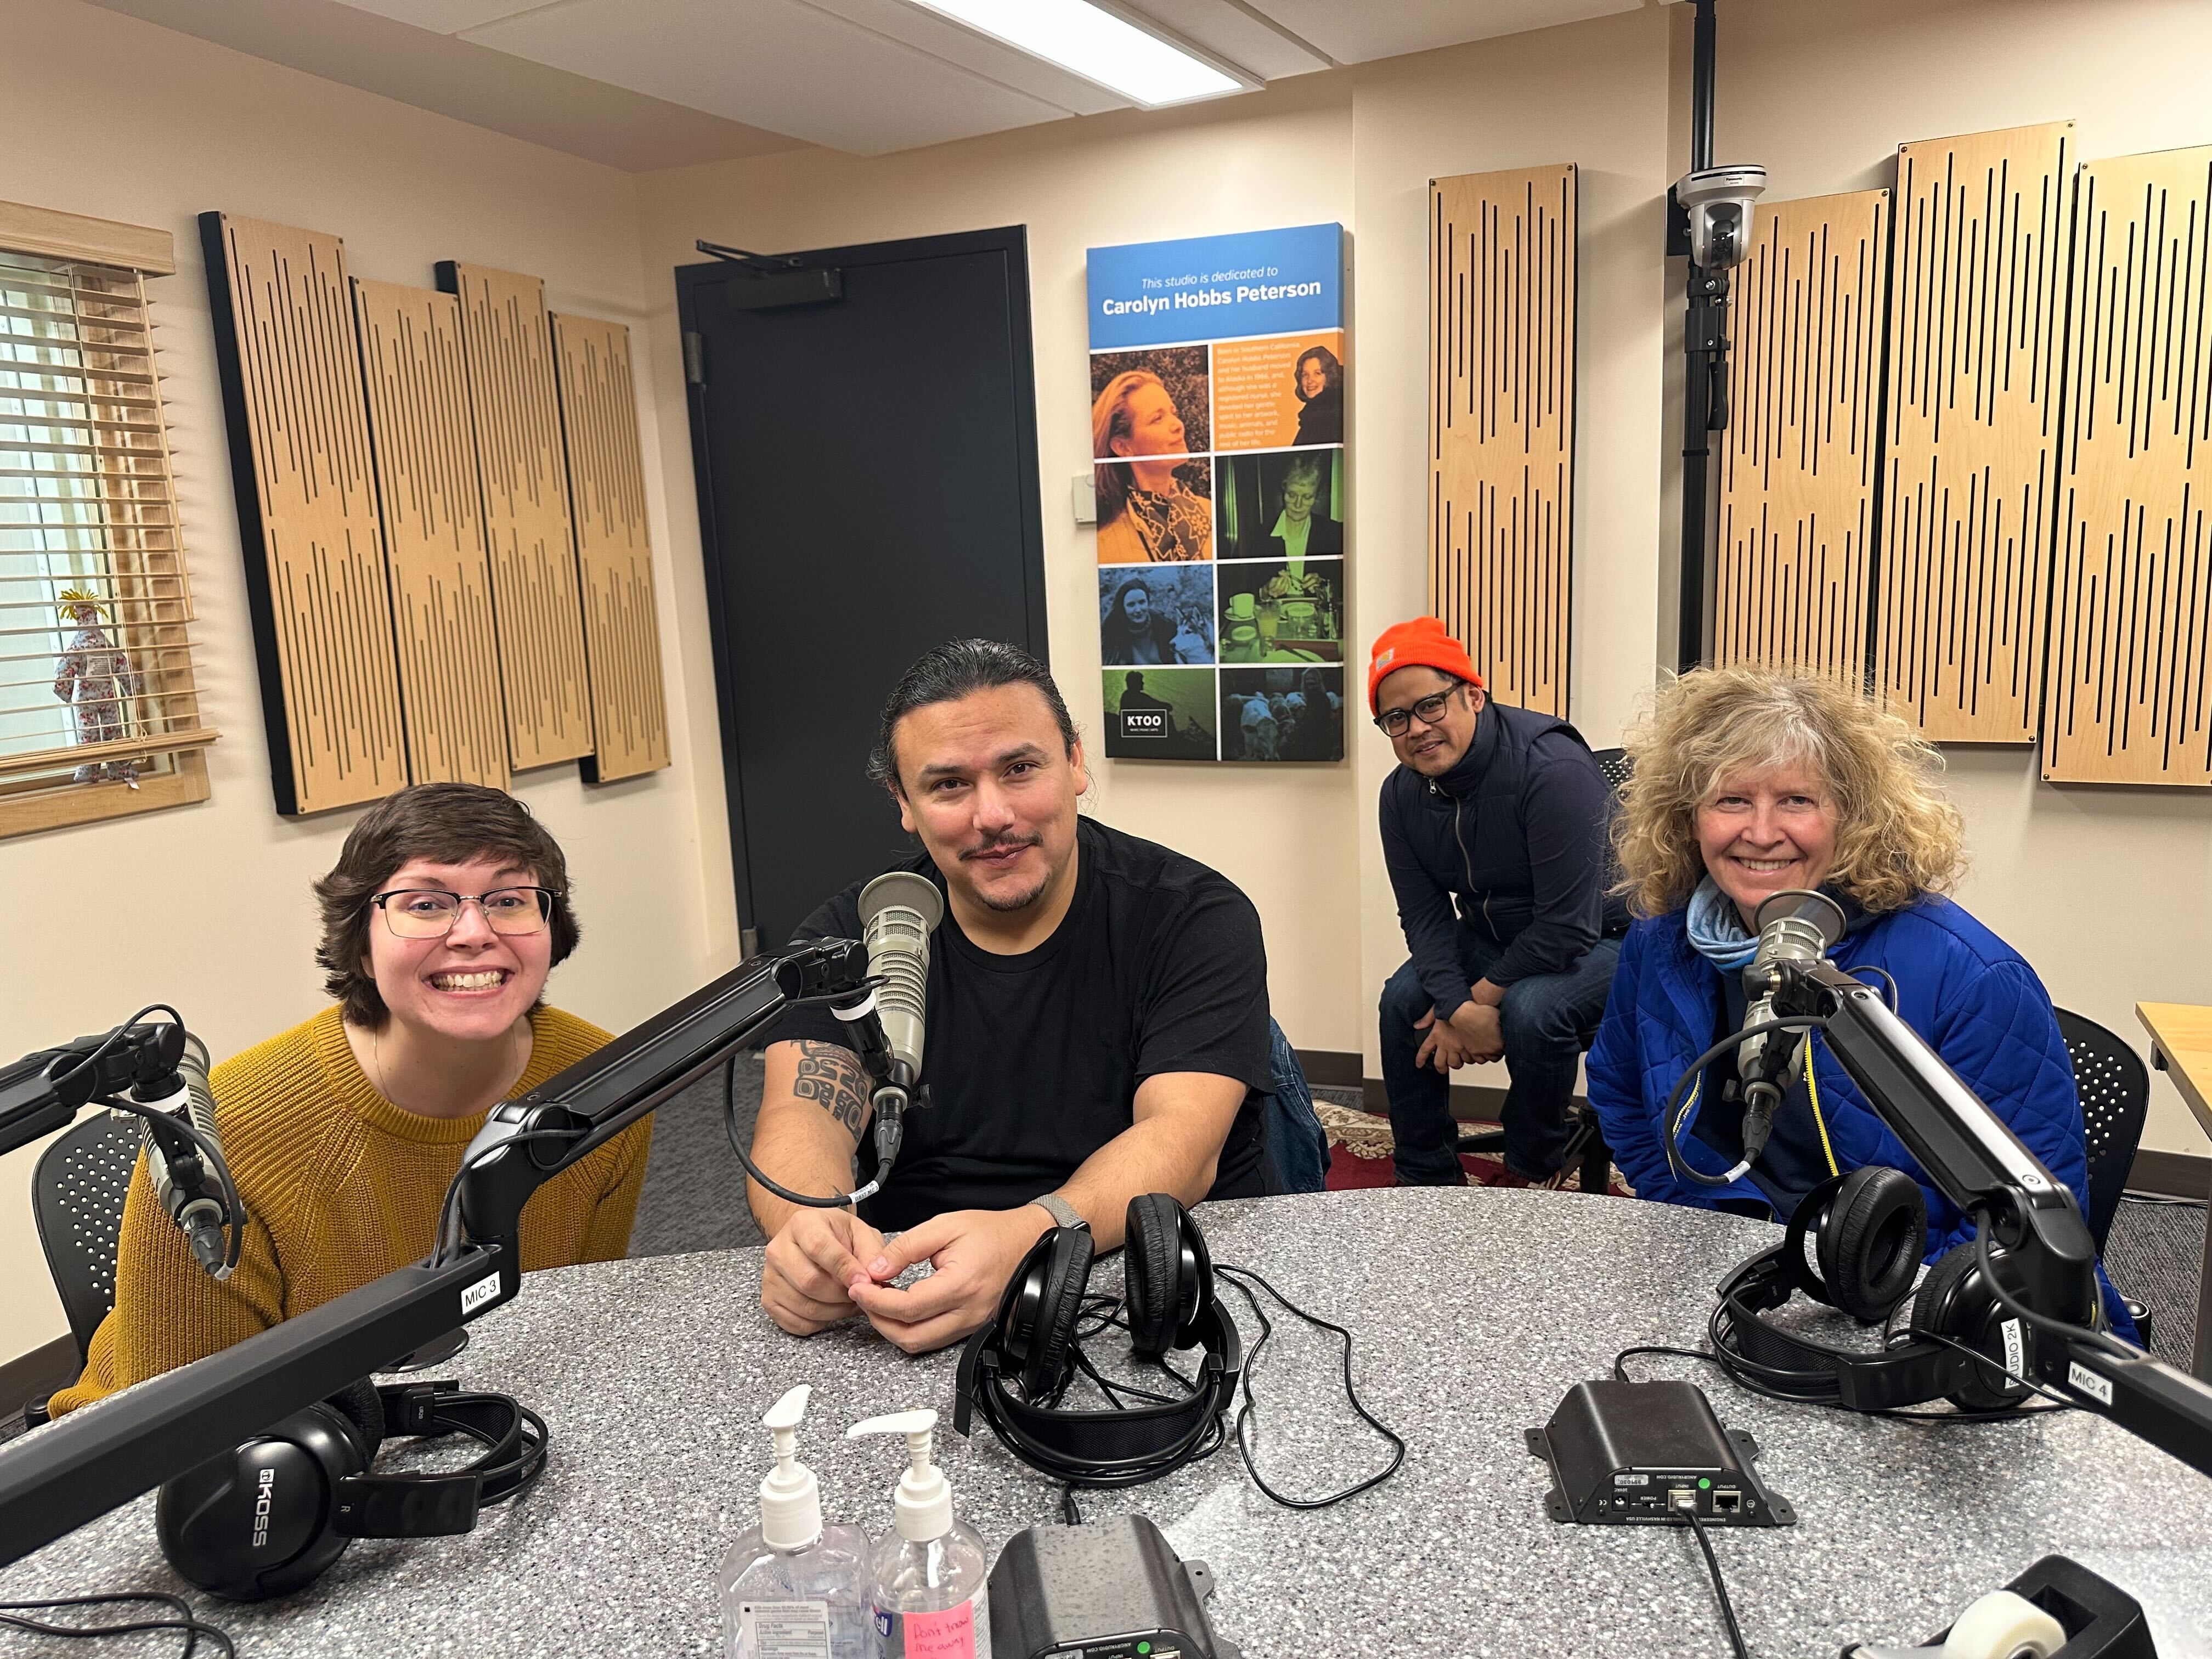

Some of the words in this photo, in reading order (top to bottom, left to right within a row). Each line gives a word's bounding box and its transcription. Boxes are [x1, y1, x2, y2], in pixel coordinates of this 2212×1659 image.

[1142, 277, 1162, 289] This
[1165, 274, 1198, 287] studio
[1200, 272, 1209, 284] is
[1211, 266, 1265, 283] dedicated
[1267, 267, 1278, 276] to
[1103, 295, 1170, 315] Carolyn
[1175, 288, 1232, 309] Hobbs
[1237, 281, 1321, 302] Peterson
[1127, 715, 1161, 726] KTOO
[466, 1285, 486, 1307] MIC
[490, 1280, 496, 1293] 3
[2006, 1323, 2017, 1340] 2K
[2072, 1368, 2095, 1390] MIC
[2099, 1385, 2106, 1396] 4
[253, 1483, 273, 1546] KOSS
[913, 1621, 941, 1639] Don't
[1087, 1642, 1131, 1653] ANGRYAUDIO.COM
